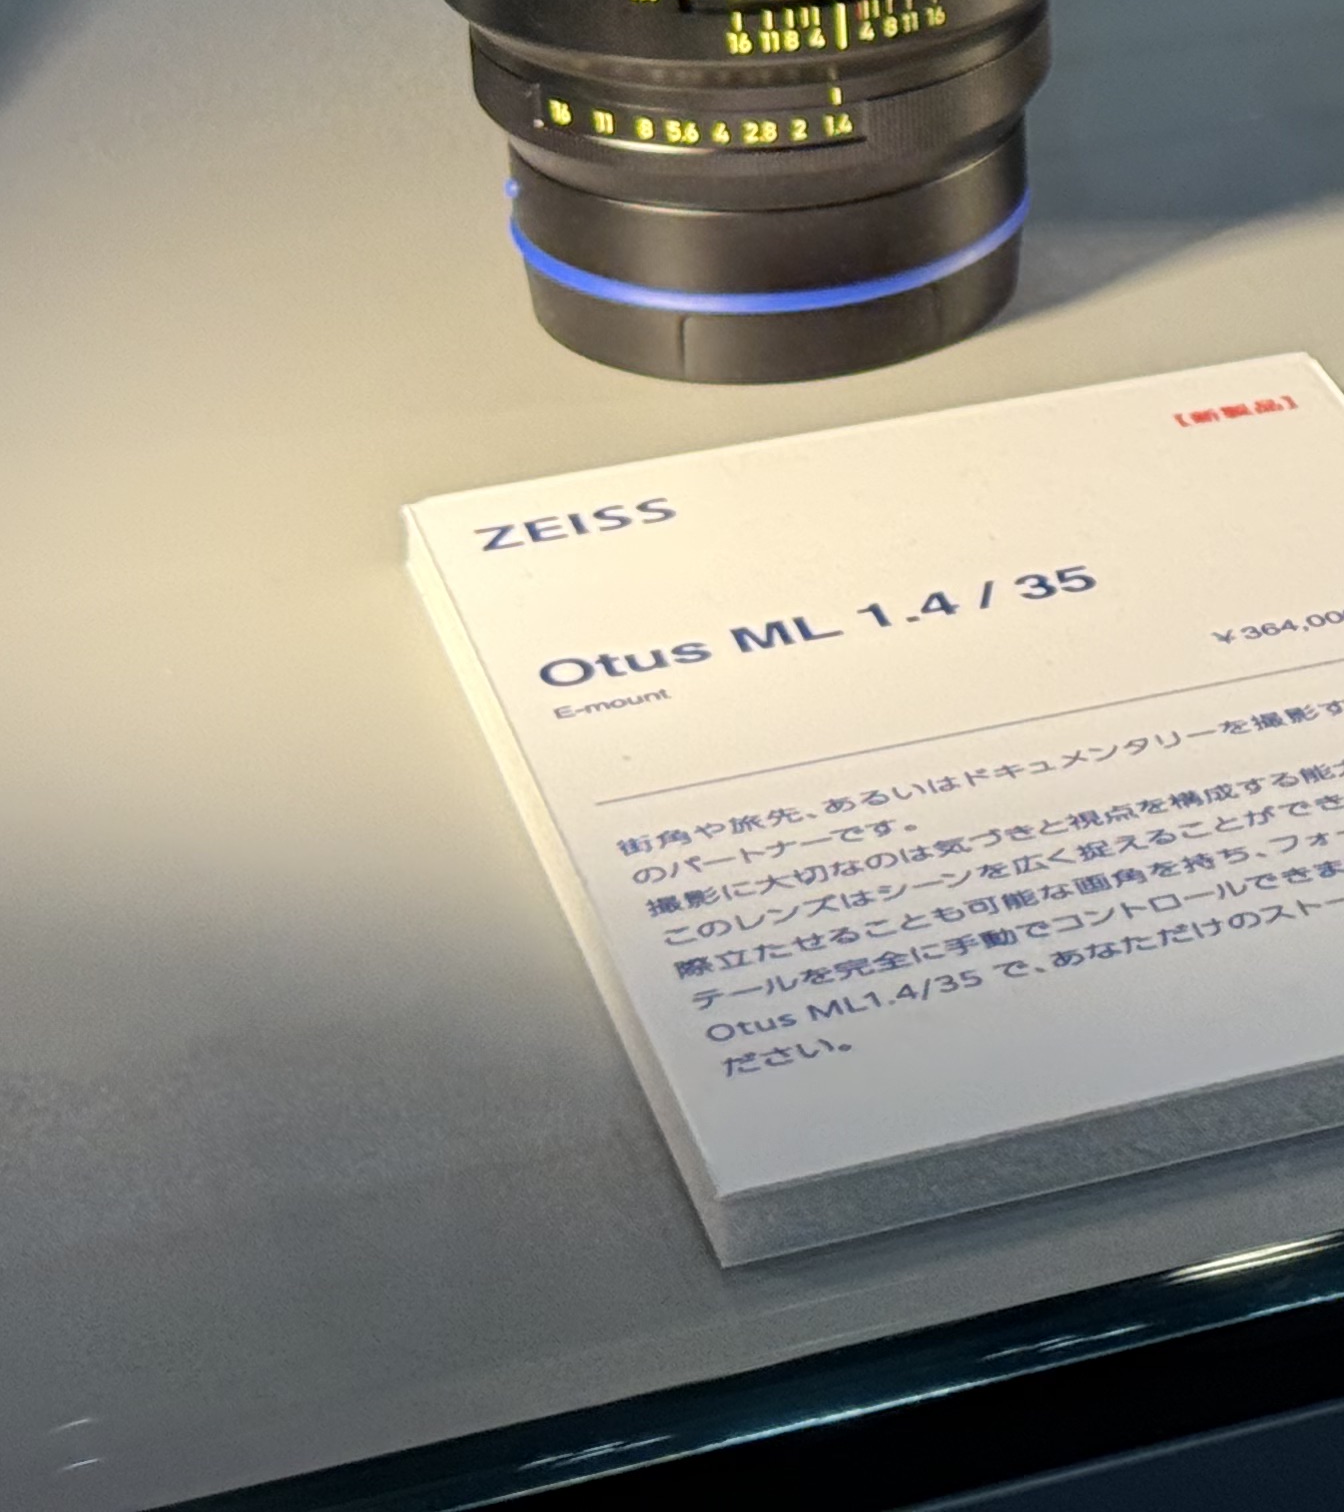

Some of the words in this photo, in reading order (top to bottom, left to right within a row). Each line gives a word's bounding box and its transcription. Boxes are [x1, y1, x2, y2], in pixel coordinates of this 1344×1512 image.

[725, 31, 753, 55] 16
[758, 30, 781, 53] 11
[782, 29, 800, 52] 8
[808, 27, 827, 49] 4
[858, 20, 875, 41] 4
[882, 15, 898, 38] 8
[901, 10, 919, 33] 11
[548, 98, 572, 126] 16
[592, 109, 615, 135] 11
[635, 116, 654, 140] 8
[664, 119, 700, 144] 5.6
[711, 121, 731, 145] 4
[742, 120, 778, 144] 2.8
[791, 117, 808, 141] 2
[823, 112, 853, 137] 1.4
[473, 496, 678, 552] ZEISS
[537, 640, 713, 688] Otus
[728, 615, 844, 654] ML
[855, 590, 960, 628] 1.4
[978, 579, 996, 610] /
[1013, 564, 1098, 601] 35
[552, 687, 672, 720] E-mount
[631, 818, 918, 885] のパートナーです。
[705, 1011, 798, 1043] Otus
[806, 969, 984, 1021] ML1.4/35
[721, 1038, 853, 1078] ださい。
